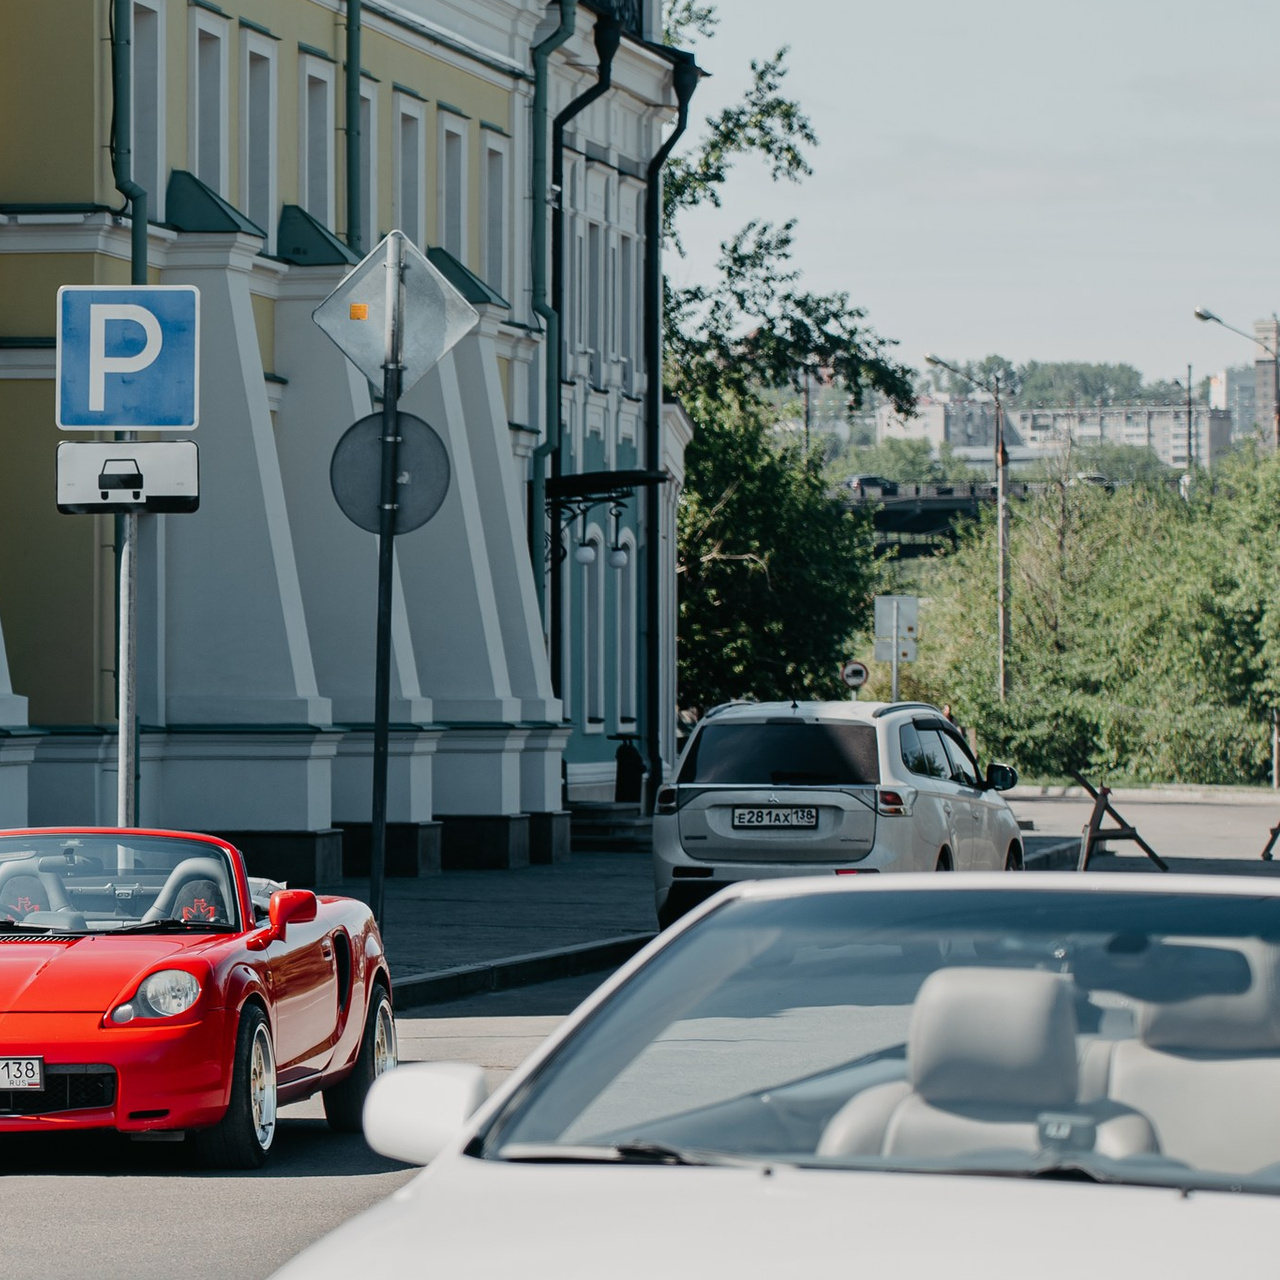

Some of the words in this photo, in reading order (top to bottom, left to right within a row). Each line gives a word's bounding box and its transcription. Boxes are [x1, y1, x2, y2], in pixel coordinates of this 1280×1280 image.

[89, 303, 163, 412] P
[737, 810, 791, 824] Е281АХ
[793, 809, 813, 821] 138
[1, 1061, 35, 1079] 138
[9, 1079, 27, 1087] RUS
